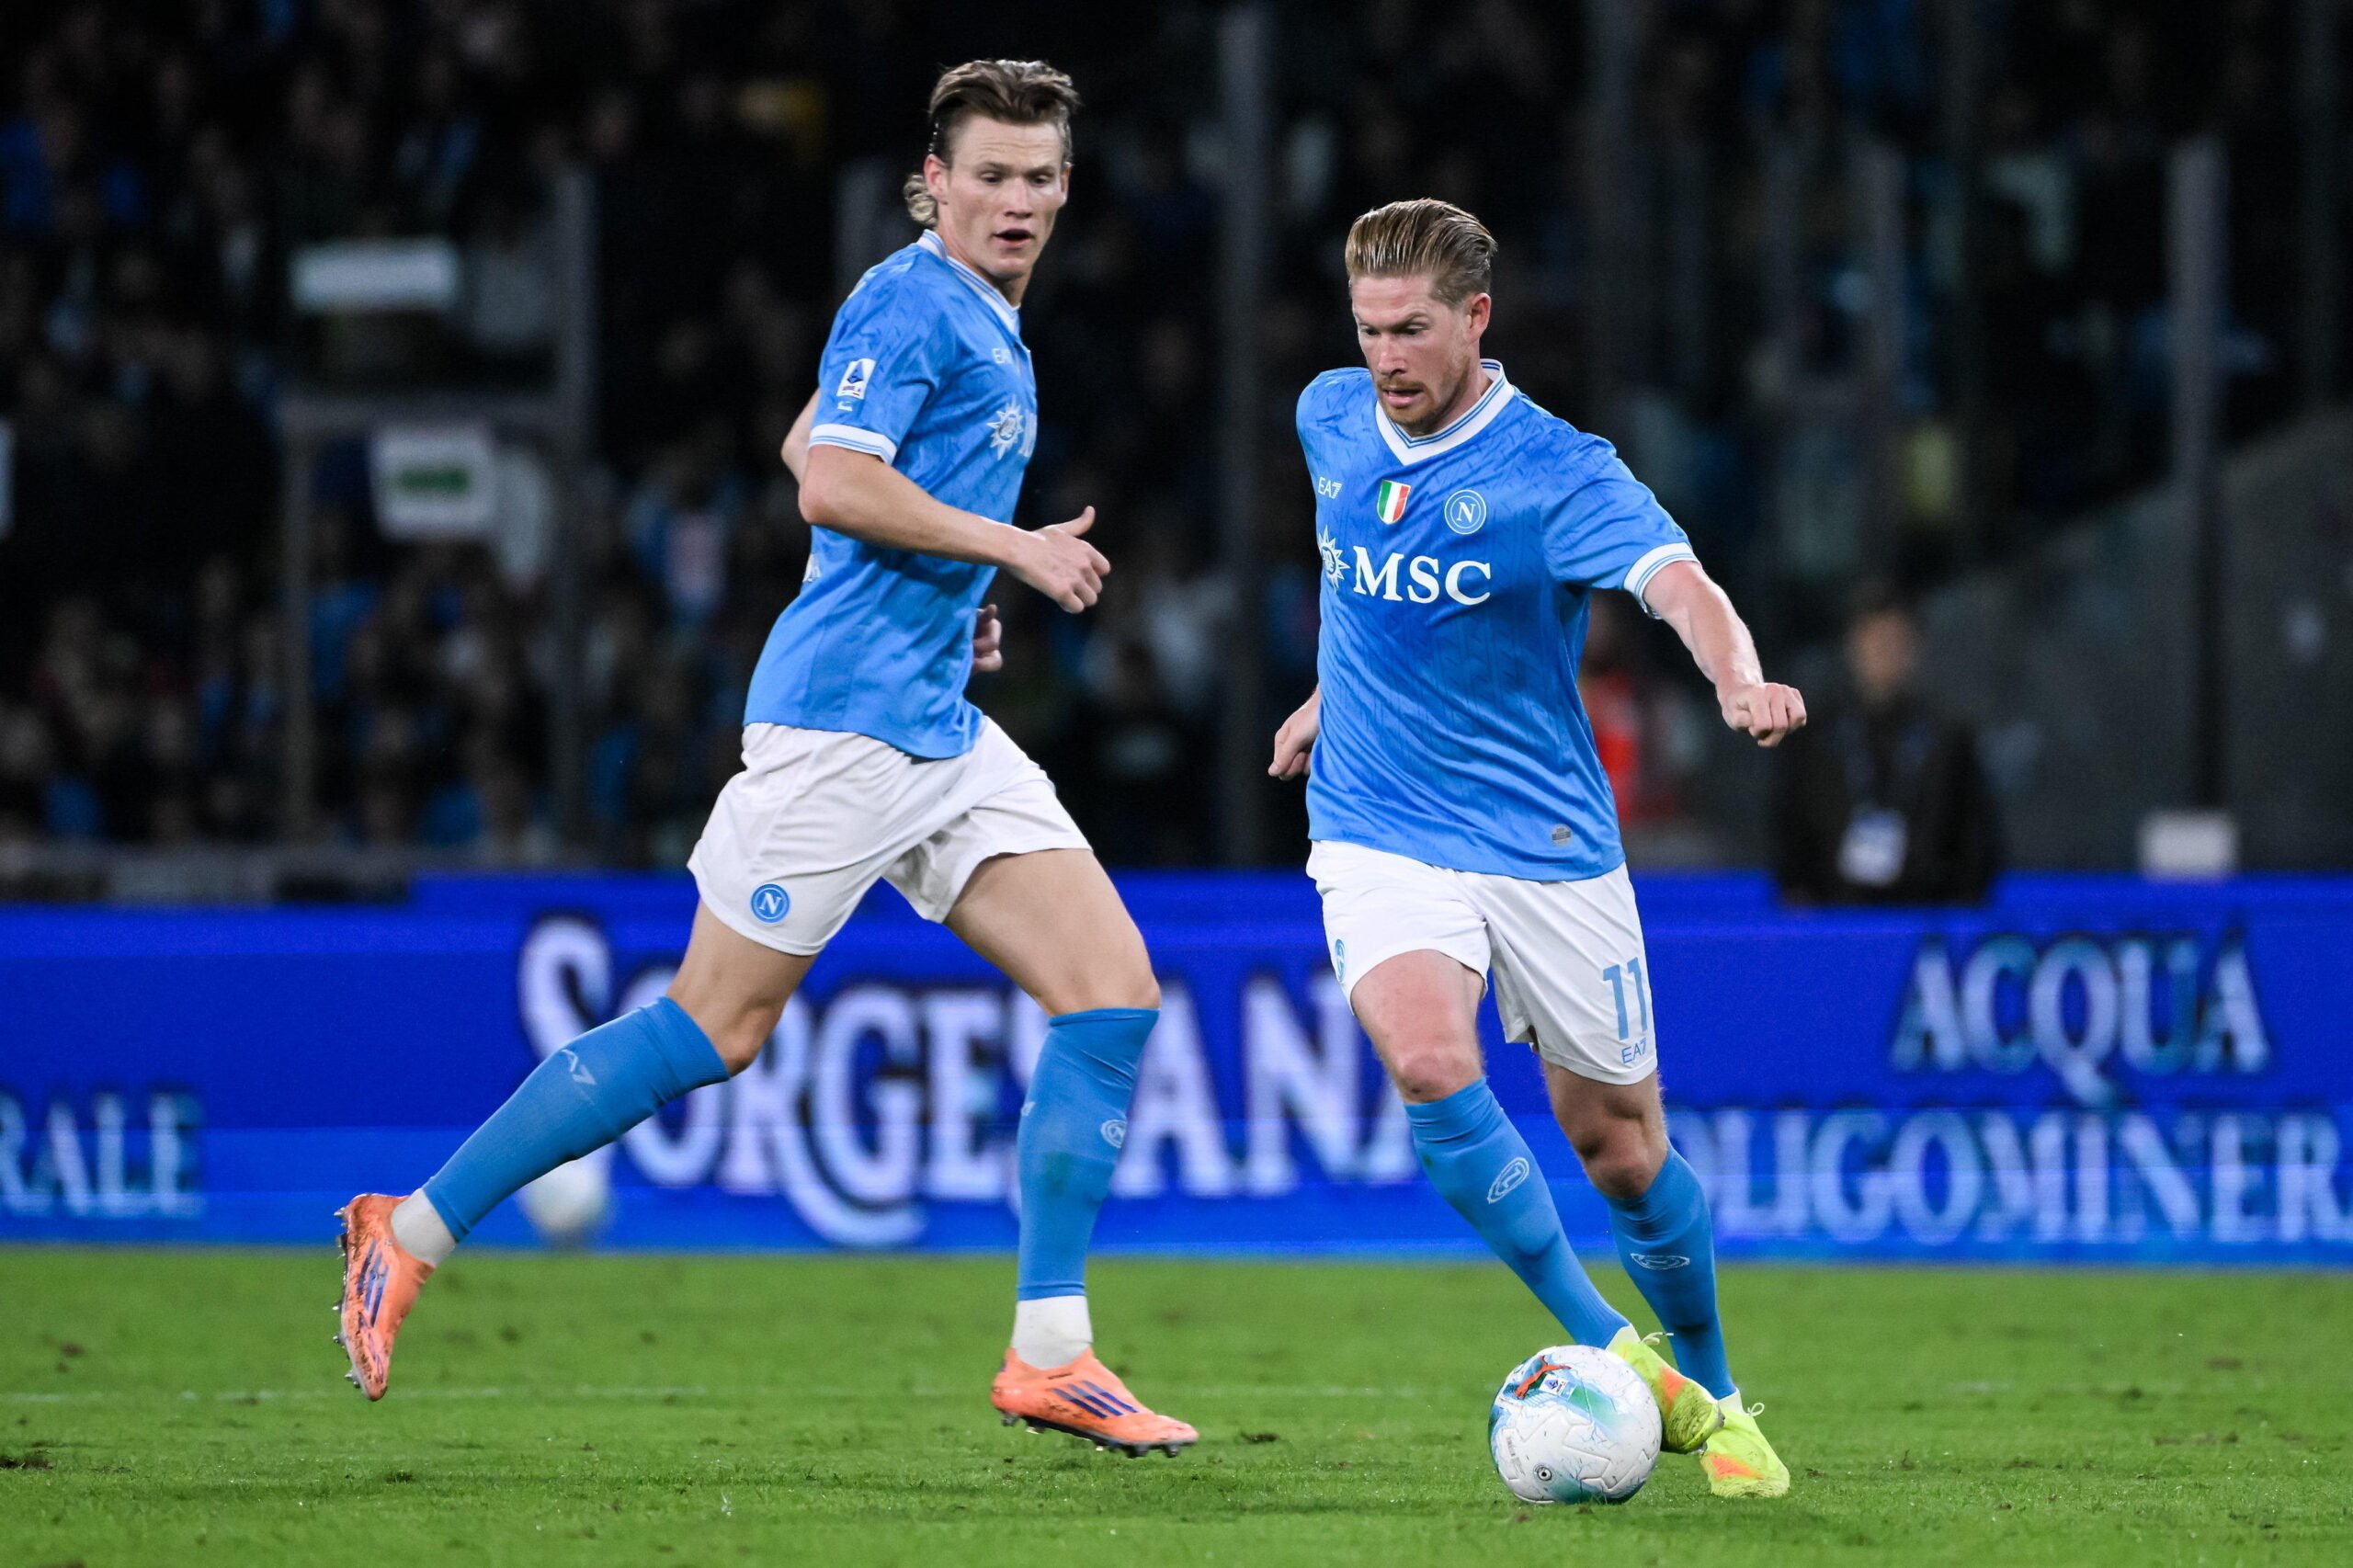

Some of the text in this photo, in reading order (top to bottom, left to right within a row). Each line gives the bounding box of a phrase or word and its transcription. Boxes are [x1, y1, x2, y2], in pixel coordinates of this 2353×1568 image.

[1318, 476, 1343, 499] EA7
[1457, 502, 1476, 523] N
[1353, 545, 1491, 606] MSC
[758, 892, 783, 915] N
[1602, 957, 1647, 1040] 11
[1891, 930, 2270, 1108] ACQUA
[1621, 1038, 1647, 1063] EA7
